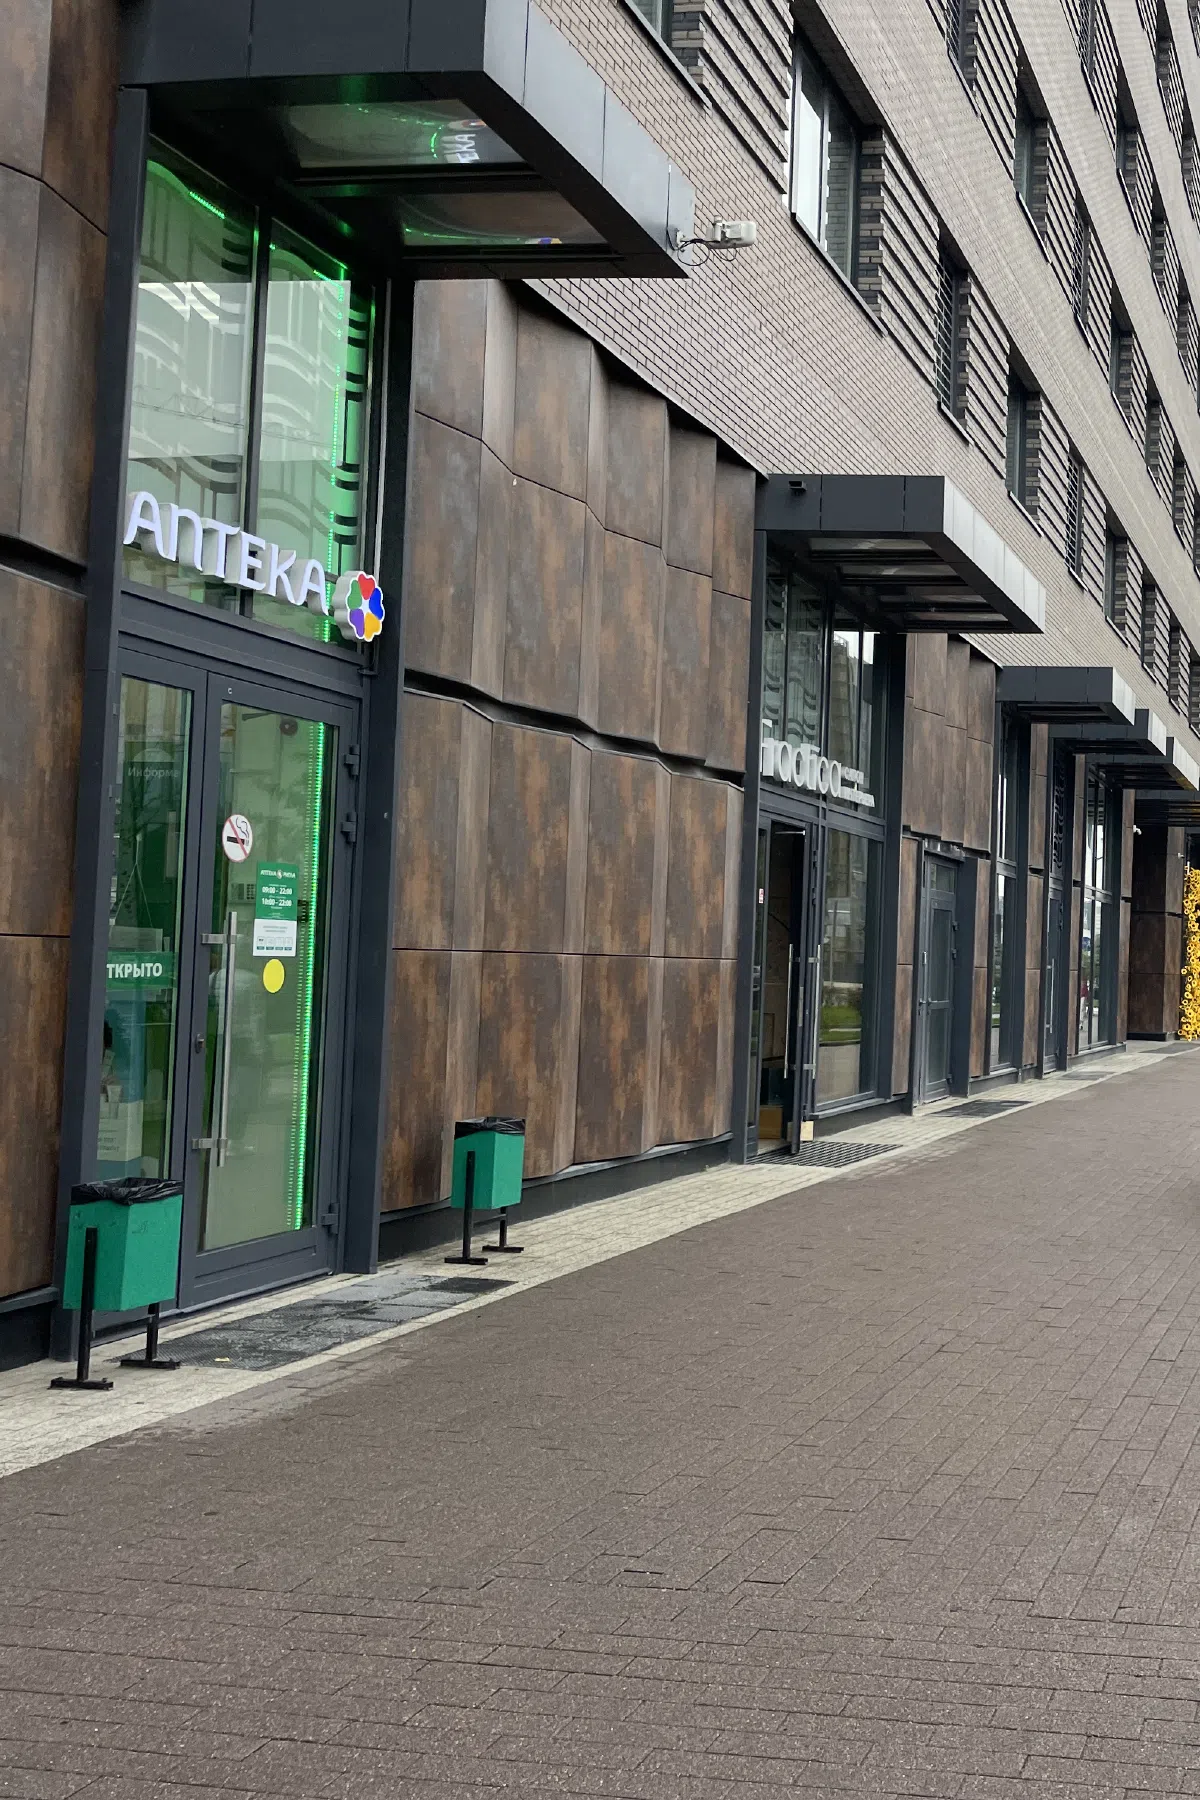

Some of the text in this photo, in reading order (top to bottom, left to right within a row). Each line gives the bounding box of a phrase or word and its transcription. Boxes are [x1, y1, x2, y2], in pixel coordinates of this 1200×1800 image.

[122, 490, 330, 616] АПТЕКА
[279, 887, 293, 895] 22:00
[106, 962, 162, 979] ТКРЫТО
